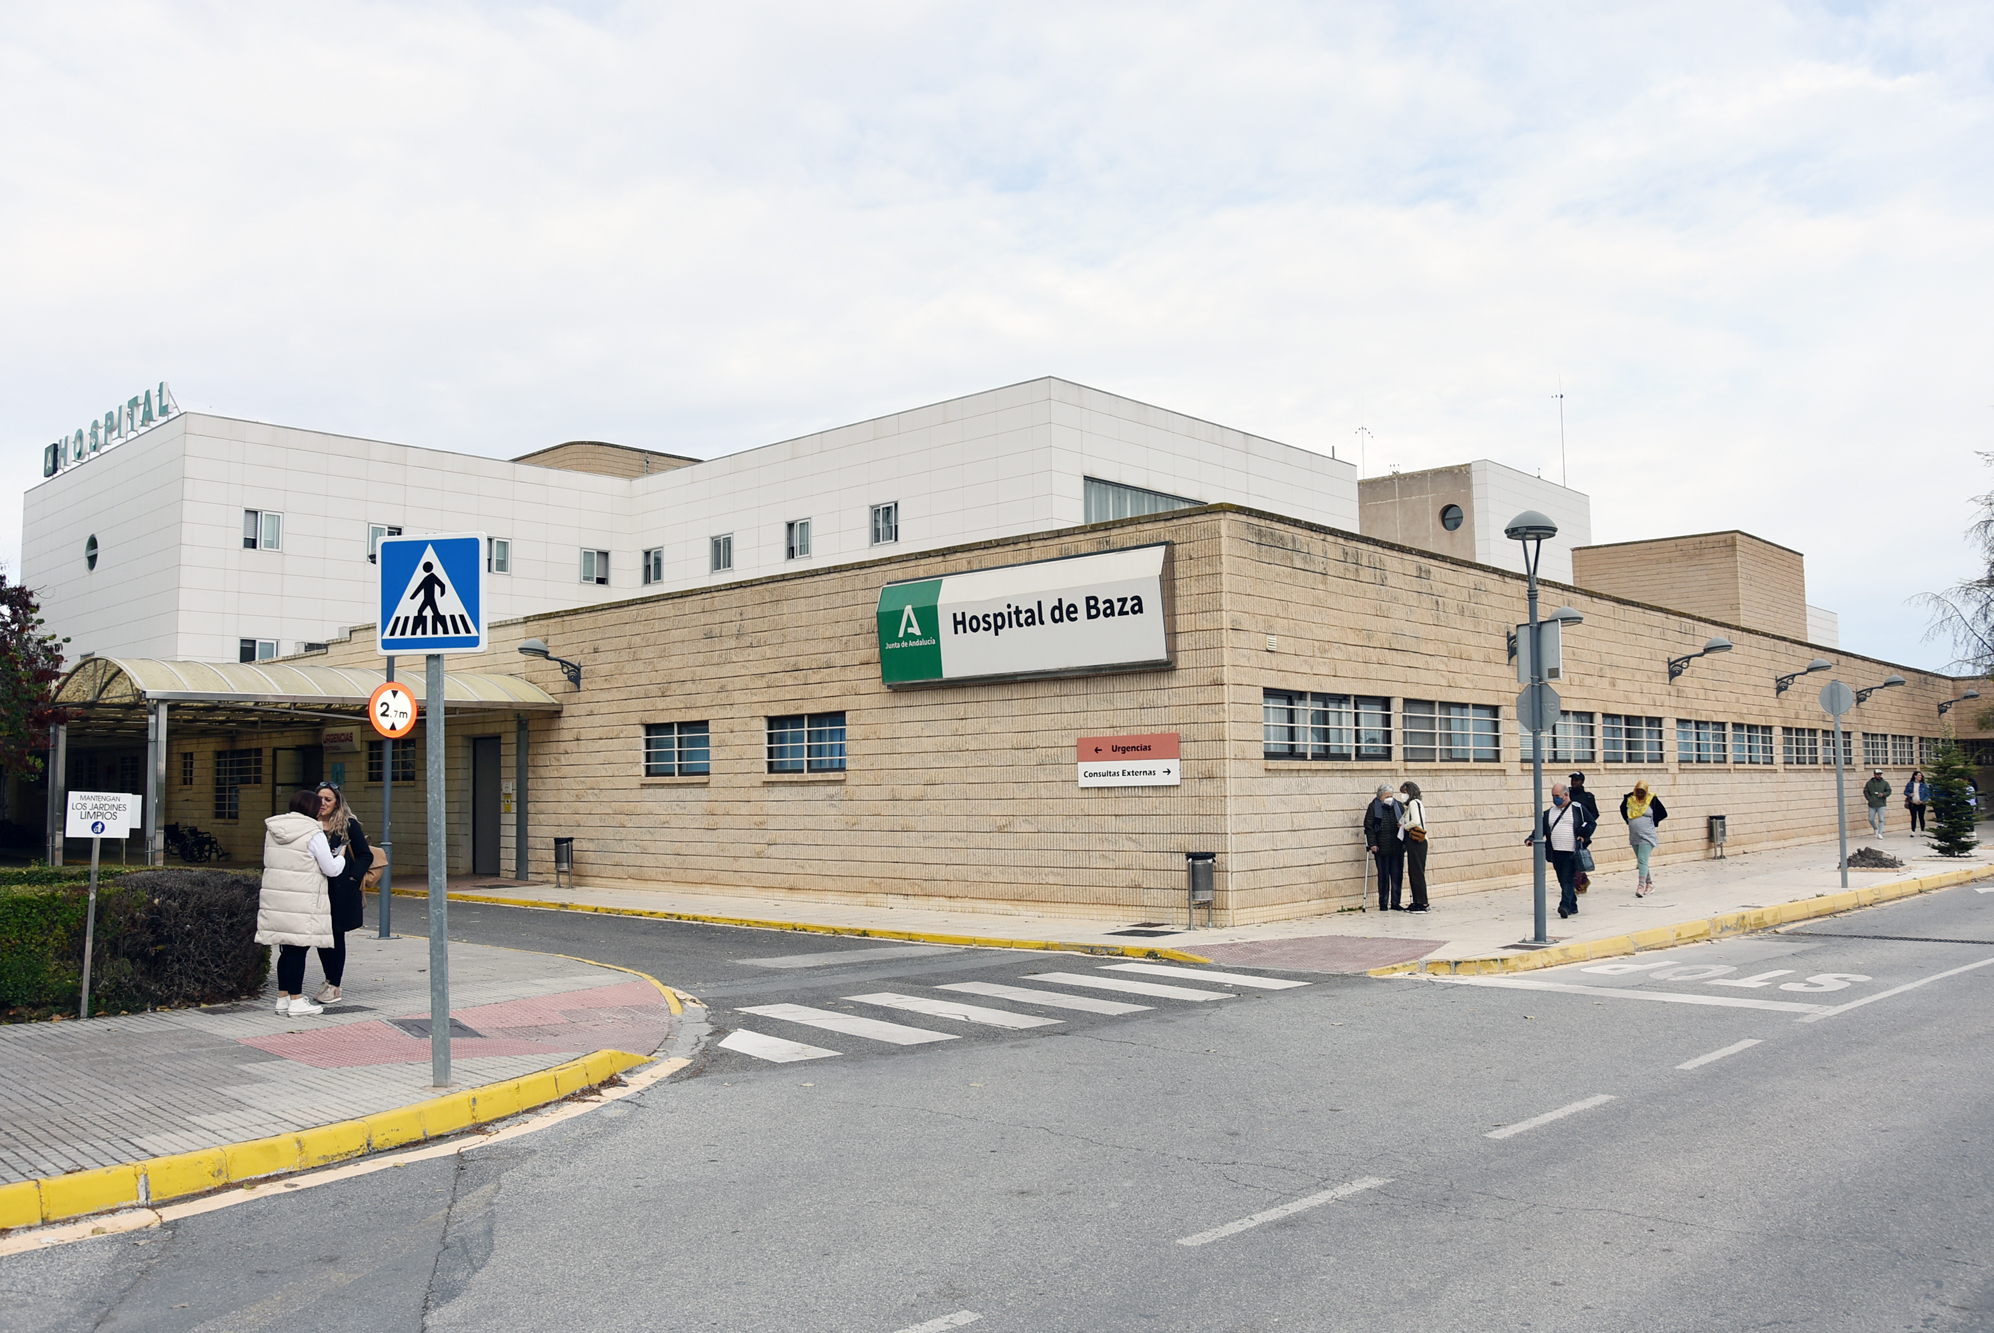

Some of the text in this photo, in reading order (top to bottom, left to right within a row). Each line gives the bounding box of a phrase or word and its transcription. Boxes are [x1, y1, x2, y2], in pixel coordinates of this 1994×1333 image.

[59, 381, 172, 469] HOSPITAL
[952, 594, 1144, 636] Hospital de Baza
[885, 636, 936, 650] Junta de Andalucía
[323, 732, 353, 744] URGENCIAS
[1112, 744, 1151, 754] Urgencias
[1083, 768, 1156, 778] Consultas Externas
[89, 803, 126, 811] JARDINES
[80, 811, 117, 820] LIMPIOS
[1580, 961, 1873, 993] STOP
